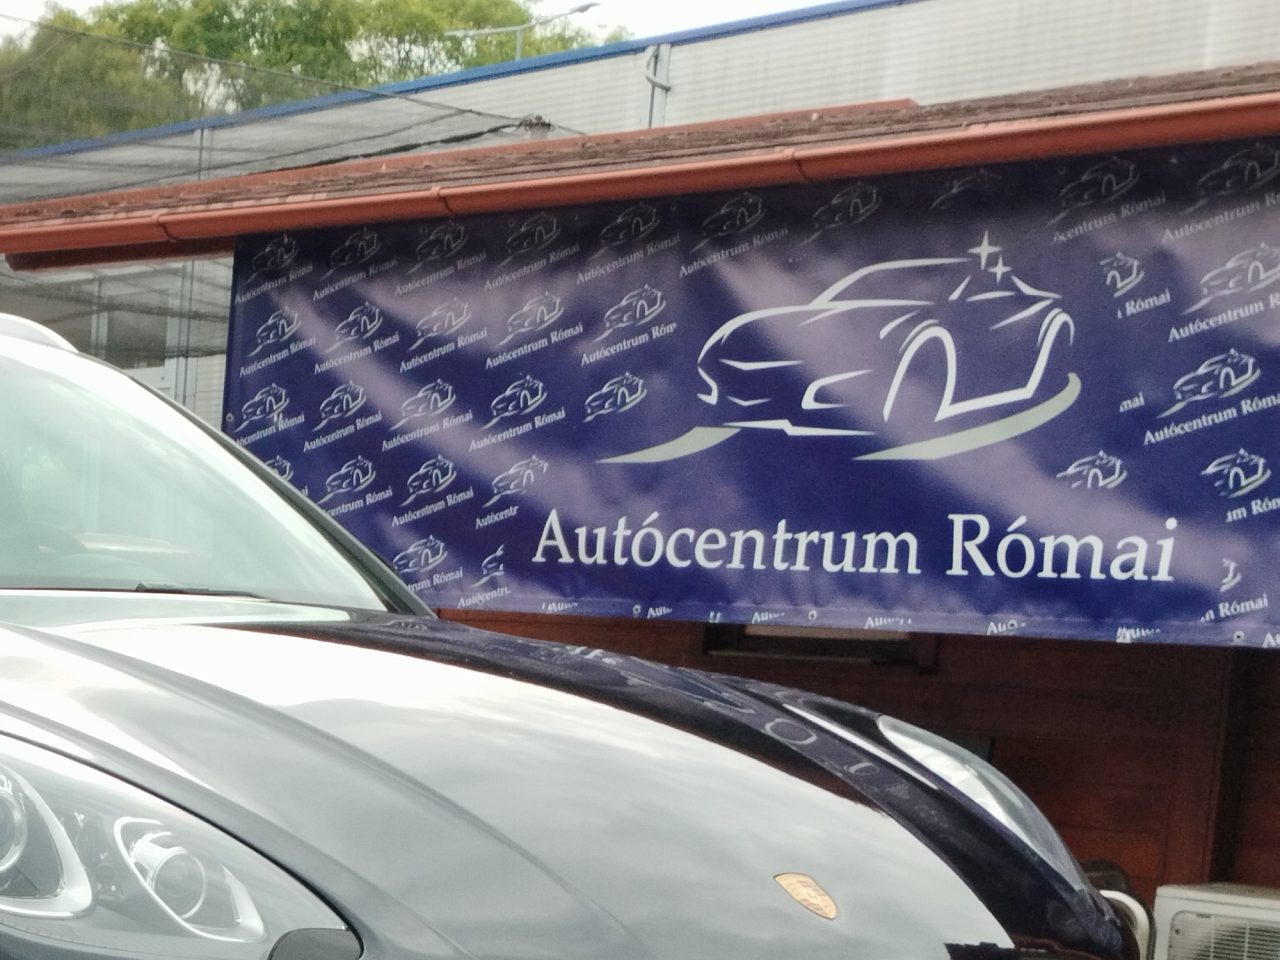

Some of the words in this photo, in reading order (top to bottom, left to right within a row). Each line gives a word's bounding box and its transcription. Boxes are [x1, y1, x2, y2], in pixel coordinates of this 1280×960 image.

[1168, 300, 1265, 343] Autócentrum
[399, 343, 455, 374] Autócentrum
[457, 327, 488, 348] Római
[485, 337, 549, 370] Autócentrum
[550, 321, 584, 343] Római
[580, 332, 649, 367] Autócentrum
[303, 422, 354, 452] Autócentrum
[356, 410, 382, 430] Római
[382, 423, 439, 451] Autócentrum
[442, 409, 473, 429] Római
[470, 423, 533, 451] Autócentrum
[534, 407, 566, 428] Római
[1143, 406, 1237, 446] Autócentrum
[365, 485, 393, 506] Római
[391, 499, 445, 528] Autócentrum
[447, 486, 474, 507] Római
[531, 508, 921, 574] Autócentrum
[946, 513, 1177, 582] Római
[1218, 592, 1268, 619] Római
